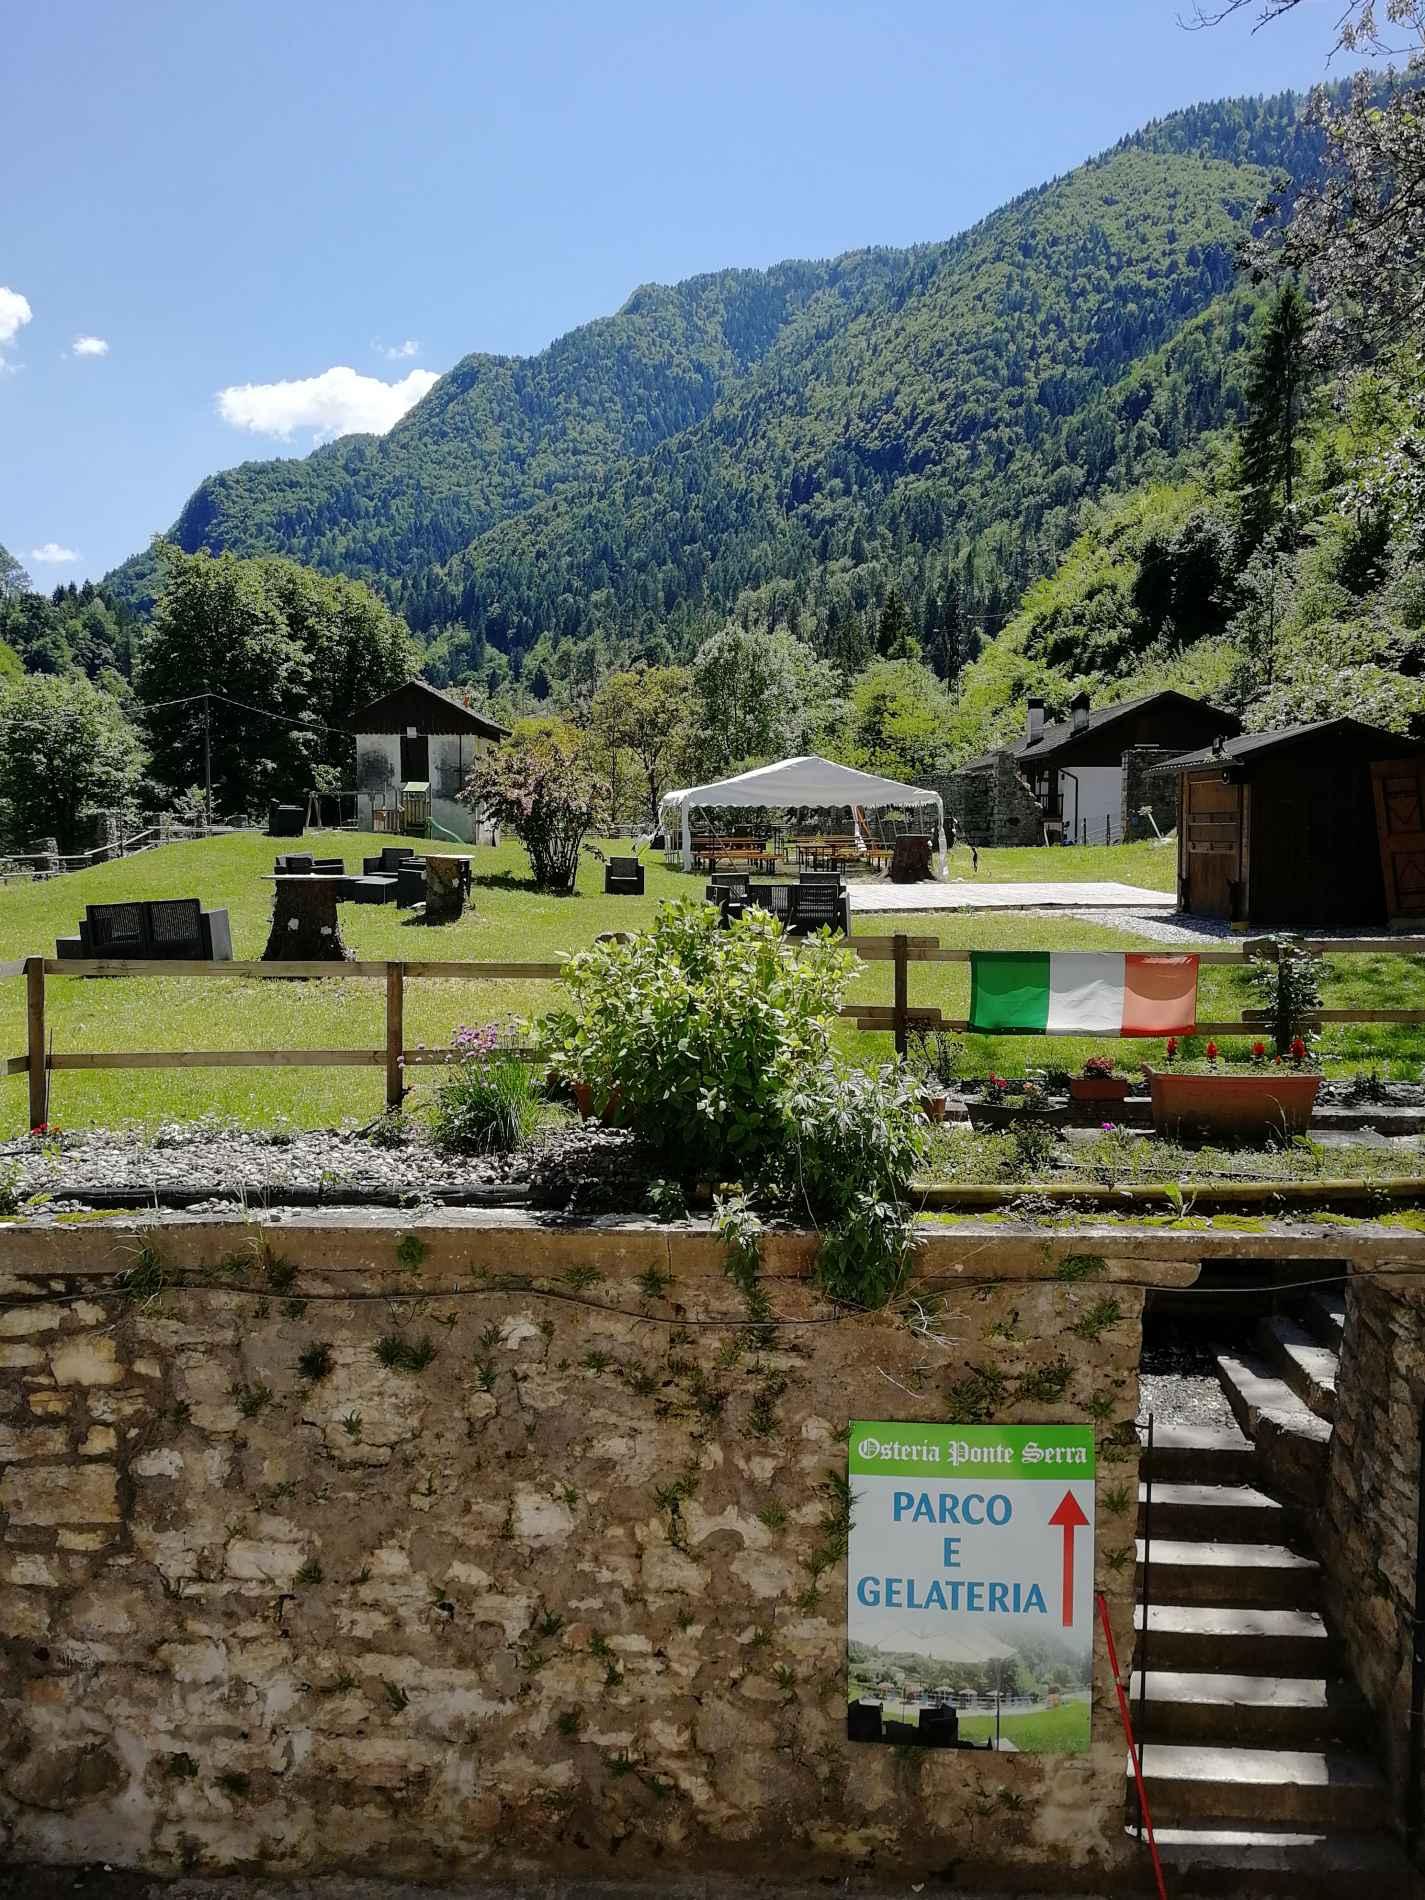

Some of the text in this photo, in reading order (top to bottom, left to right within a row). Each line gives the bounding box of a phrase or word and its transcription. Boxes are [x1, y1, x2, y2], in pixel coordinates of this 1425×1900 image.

[857, 1438, 1088, 1466] Osteria Ponte Serra
[893, 1491, 1012, 1525] PARCO
[943, 1537, 962, 1567] E
[856, 1576, 1048, 1614] GELATERIA
